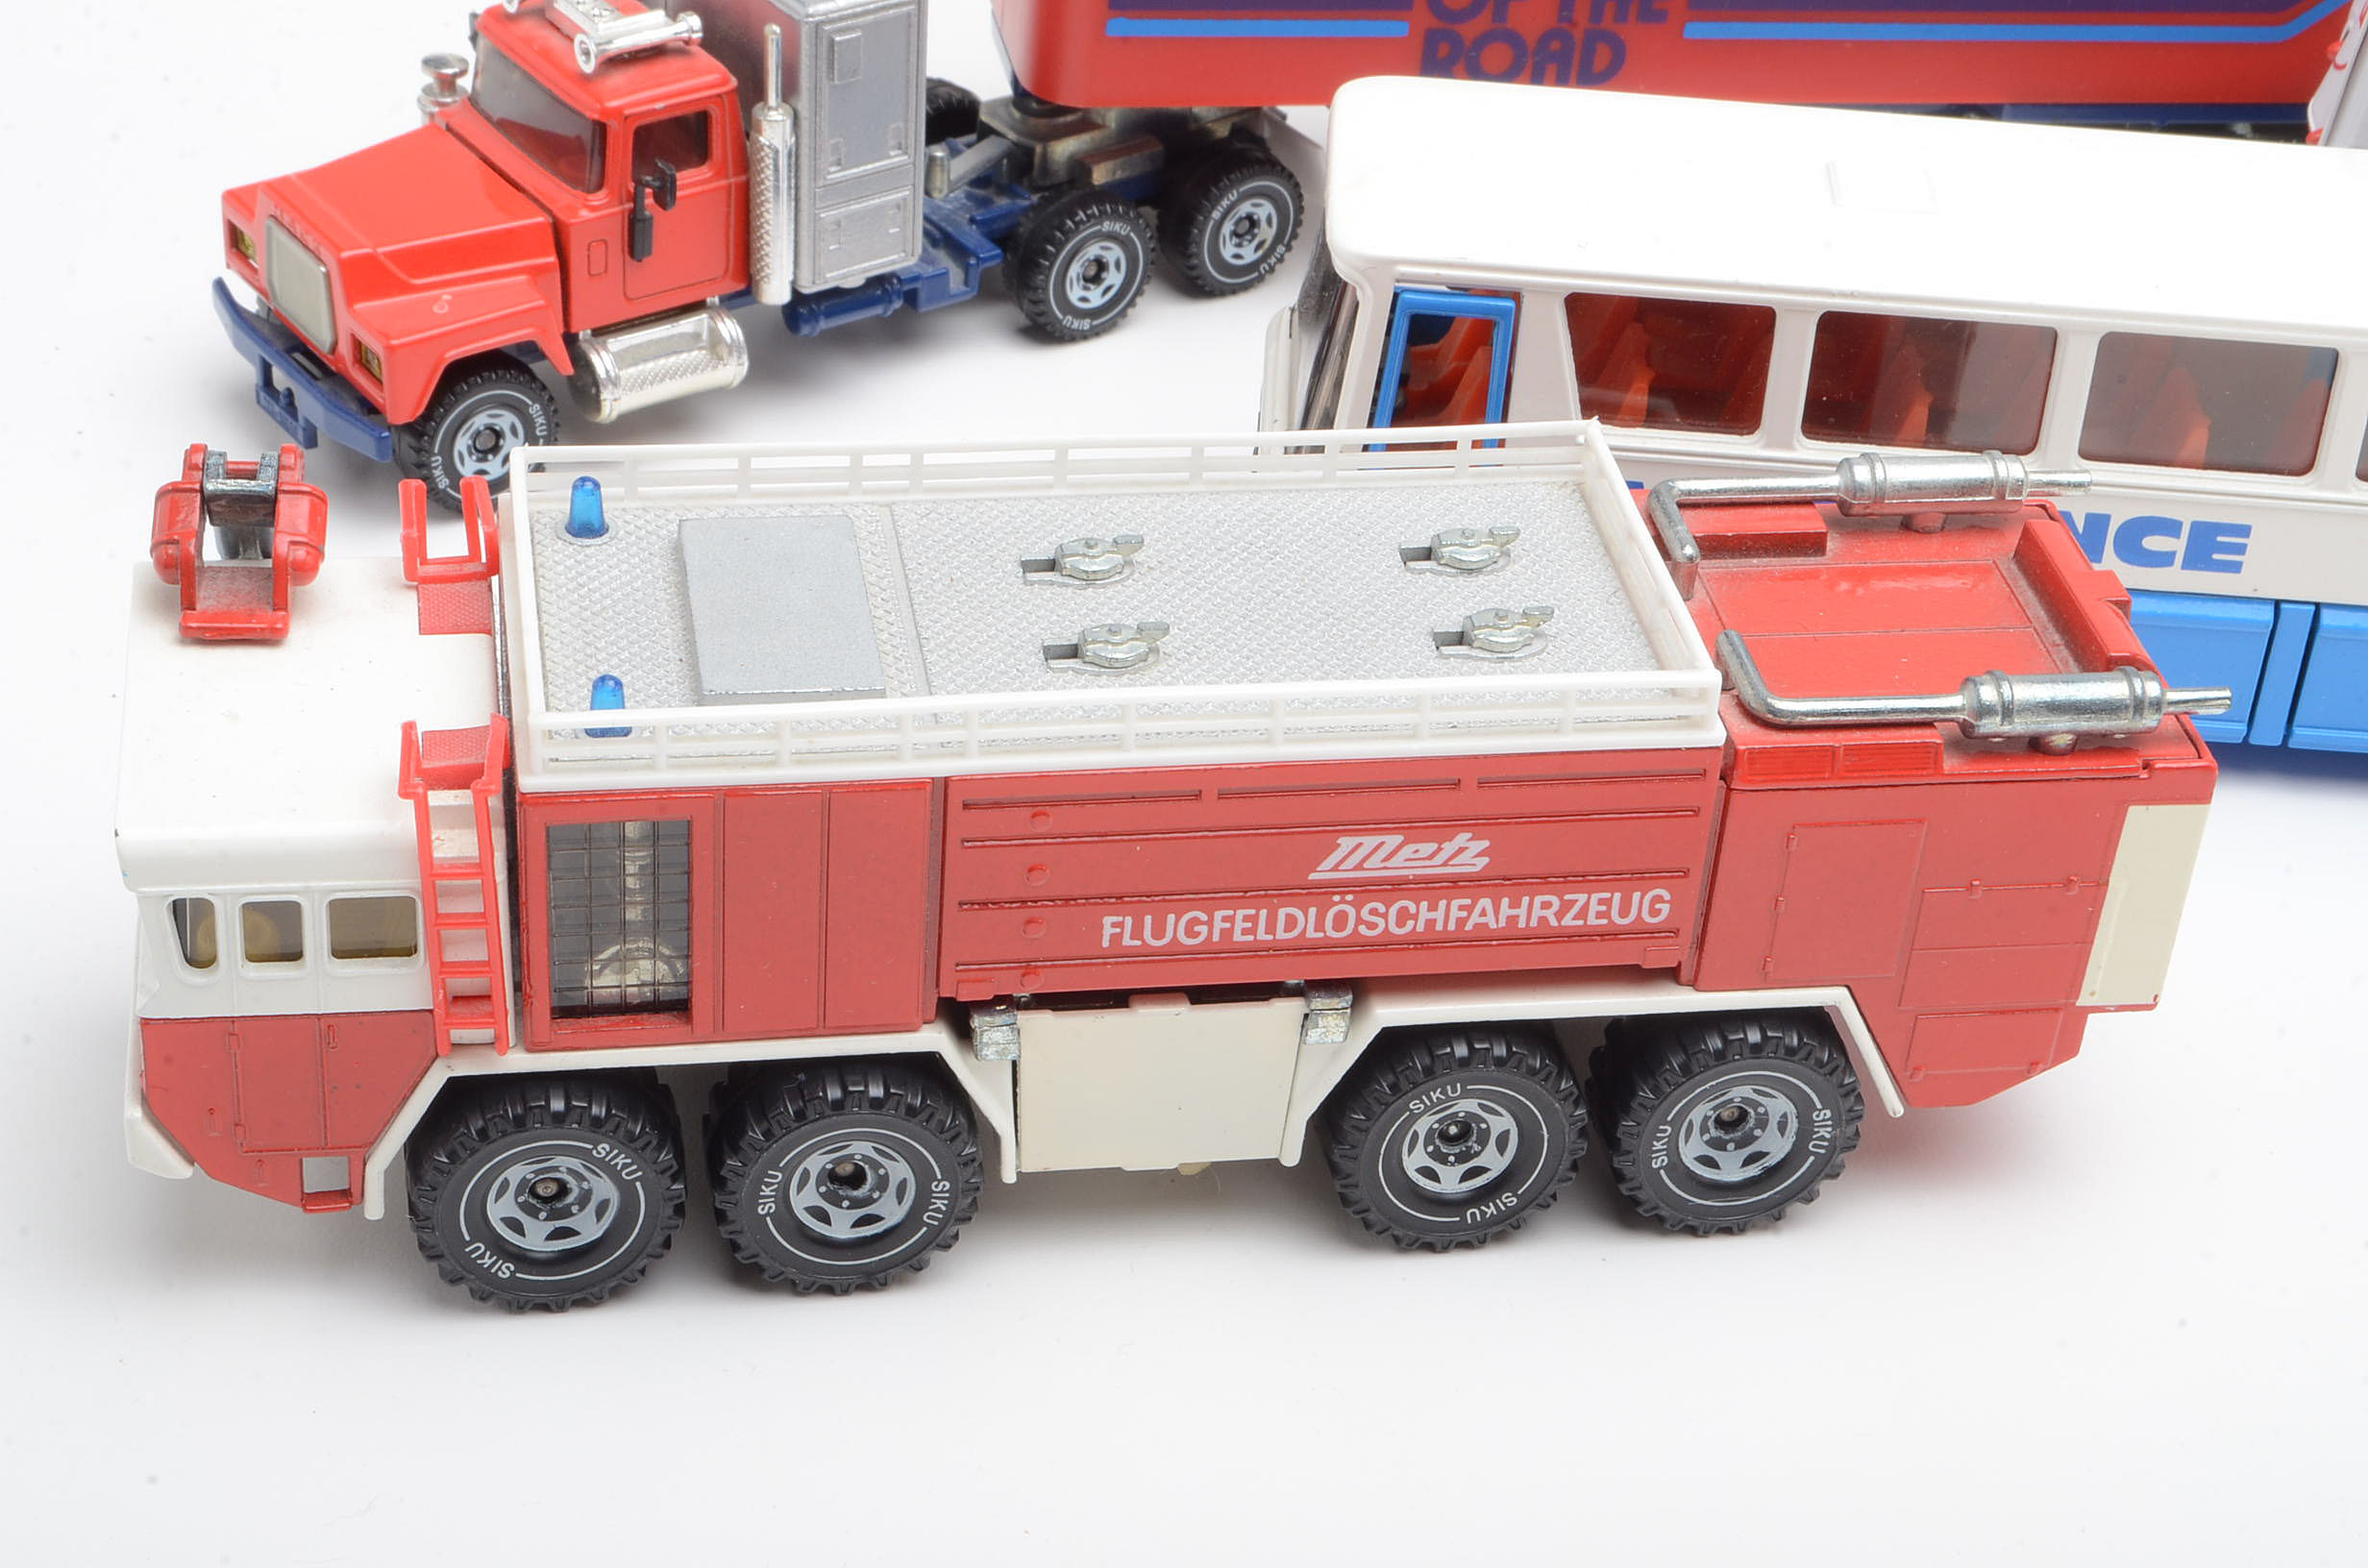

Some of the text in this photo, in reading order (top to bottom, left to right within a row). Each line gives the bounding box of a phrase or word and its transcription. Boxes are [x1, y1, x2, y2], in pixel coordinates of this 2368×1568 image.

[1419, 27, 1627, 86] ROAD
[1211, 189, 1238, 220] SIKU
[1101, 221, 1130, 235] SIKU
[1260, 244, 1286, 275] SIKU
[1062, 315, 1091, 331] SIKU
[529, 404, 547, 436] SIKU
[431, 455, 449, 489] SIKU
[1308, 832, 1491, 879] Metz
[1101, 888, 1671, 947] FLUGFELDLÖSCHFAHRZEUG
[1409, 1083, 1462, 1115] SIKU
[1651, 1125, 1672, 1169] SIKU
[1808, 1109, 1834, 1154] SIKU
[592, 1142, 643, 1181] SIKU
[757, 1169, 783, 1215] SIKU
[923, 1180, 950, 1227] SIKU
[1465, 1191, 1518, 1224] SIKU
[464, 1241, 515, 1279] SIKU
